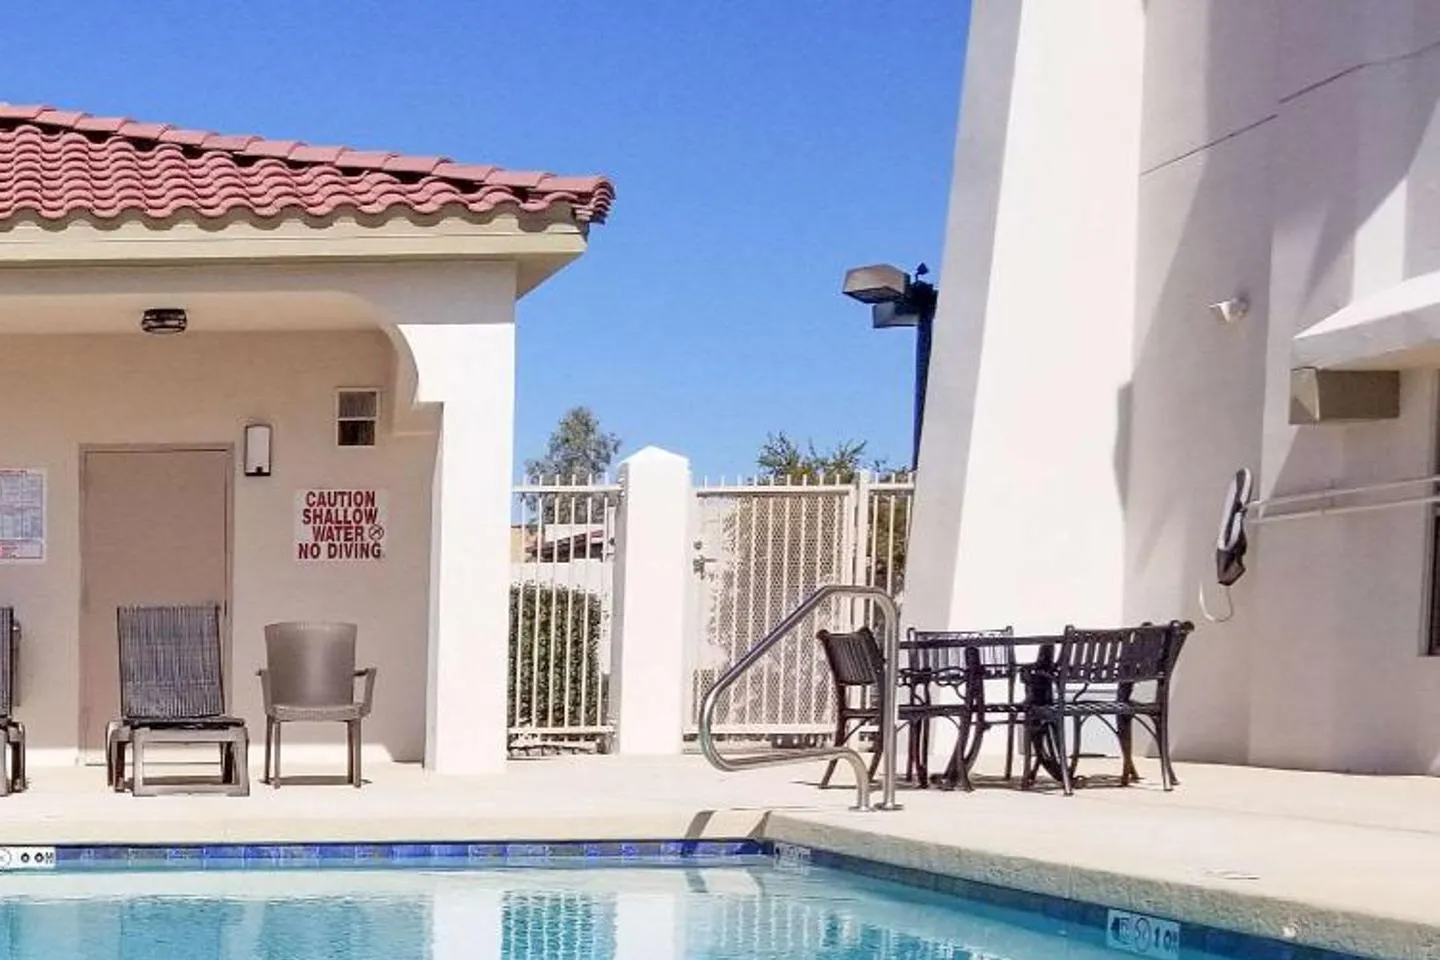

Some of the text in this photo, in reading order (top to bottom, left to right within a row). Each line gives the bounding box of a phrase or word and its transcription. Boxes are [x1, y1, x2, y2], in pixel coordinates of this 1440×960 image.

[306, 491, 375, 507] CAUTION
[302, 508, 378, 525] SHALLOW
[312, 526, 364, 542] WATER
[298, 543, 381, 559] NO DIVING
